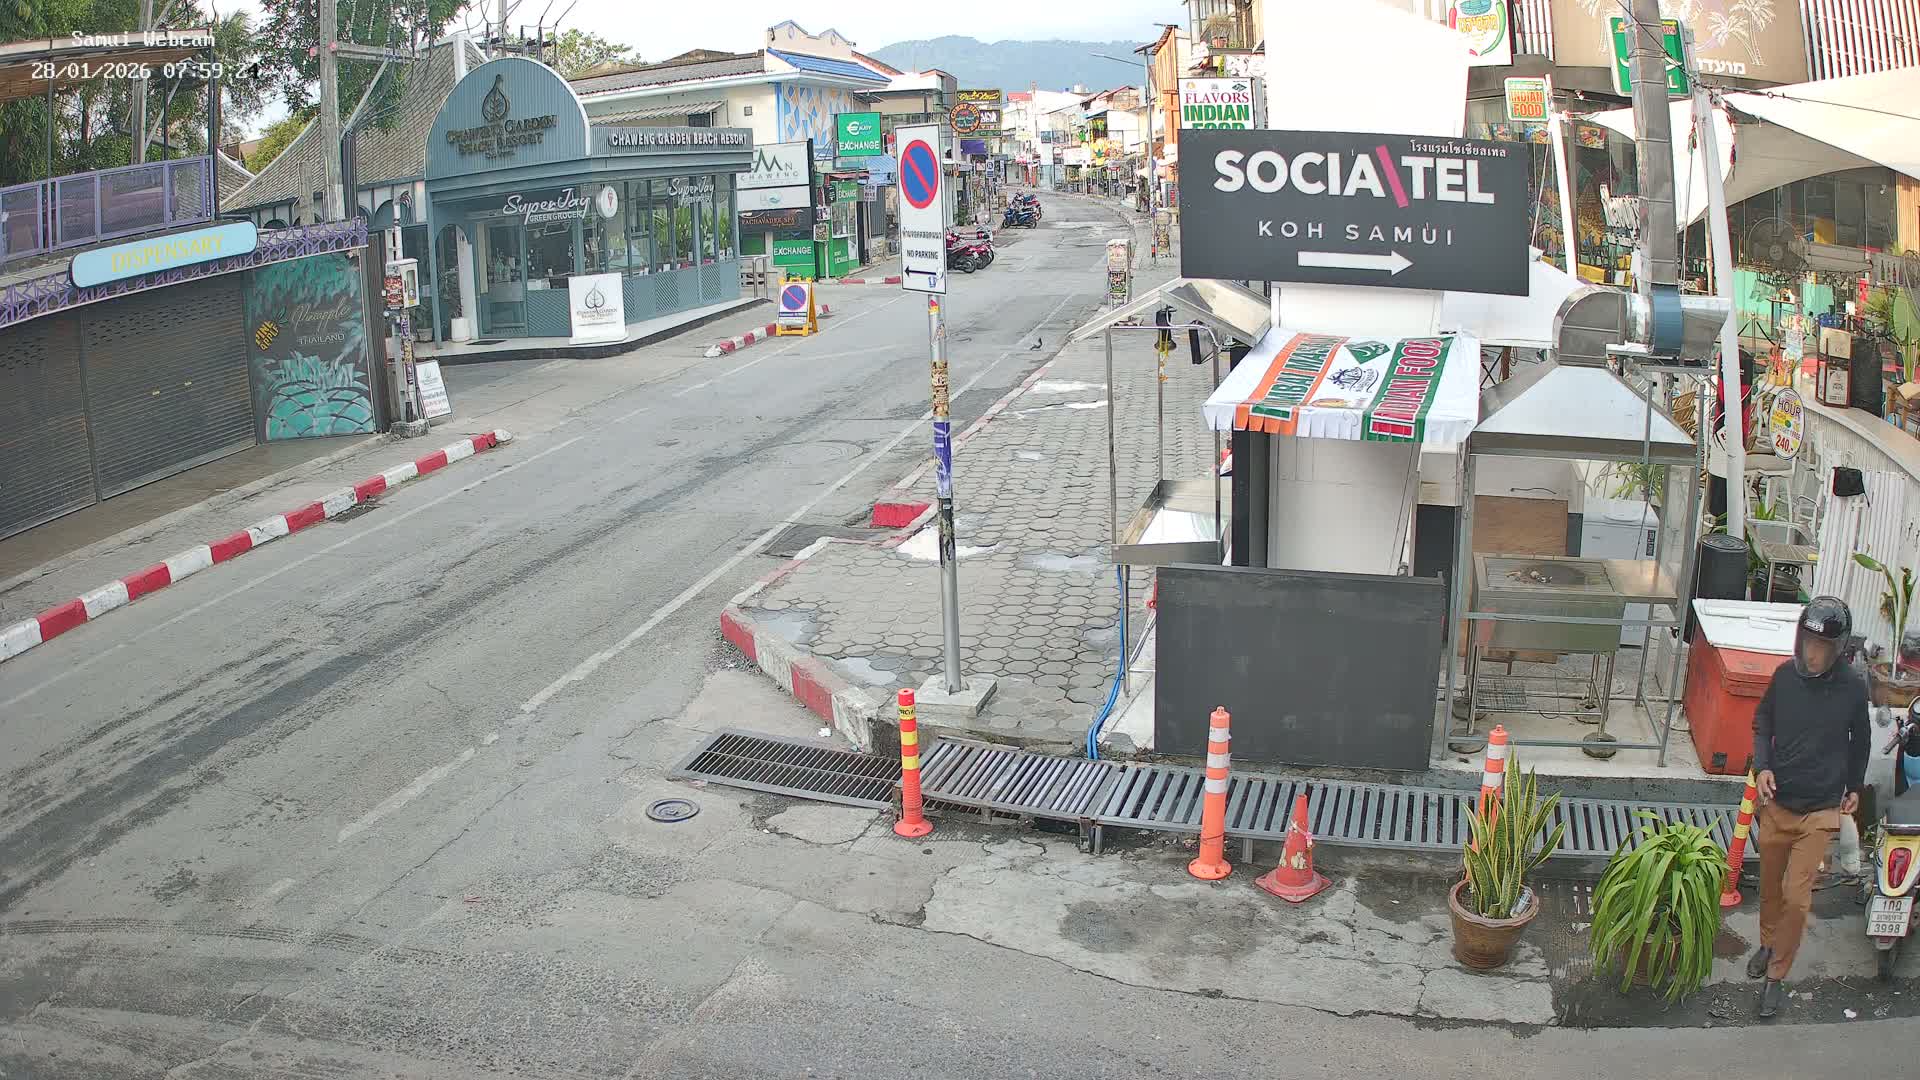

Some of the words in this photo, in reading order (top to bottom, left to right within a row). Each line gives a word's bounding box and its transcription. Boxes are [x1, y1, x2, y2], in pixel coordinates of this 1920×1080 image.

[1185, 92, 1250, 104] FLAVORS
[1511, 91, 1544, 103] INDIAN
[1184, 104, 1250, 122] INDIAN
[1513, 102, 1543, 117] FOOD
[610, 133, 655, 146] CHAWENG
[658, 133, 690, 145] GARDEN
[693, 133, 718, 145] BEACH
[720, 133, 748, 145] RESORT
[839, 140, 880, 150] EXCHANGE
[740, 172, 799, 182] CHAWENG
[1258, 220, 1324, 240] KOH
[1345, 223, 1452, 246] SAMUI
[110, 232, 225, 274] DISPENSARY
[773, 245, 813, 256] EXCHANGE
[906, 249, 915, 258] NO
[915, 250, 939, 260] PARKING
[299, 333, 345, 346] THAILAND
[1777, 397, 1801, 419] HOUR
[1873, 923, 1901, 934] 3998
